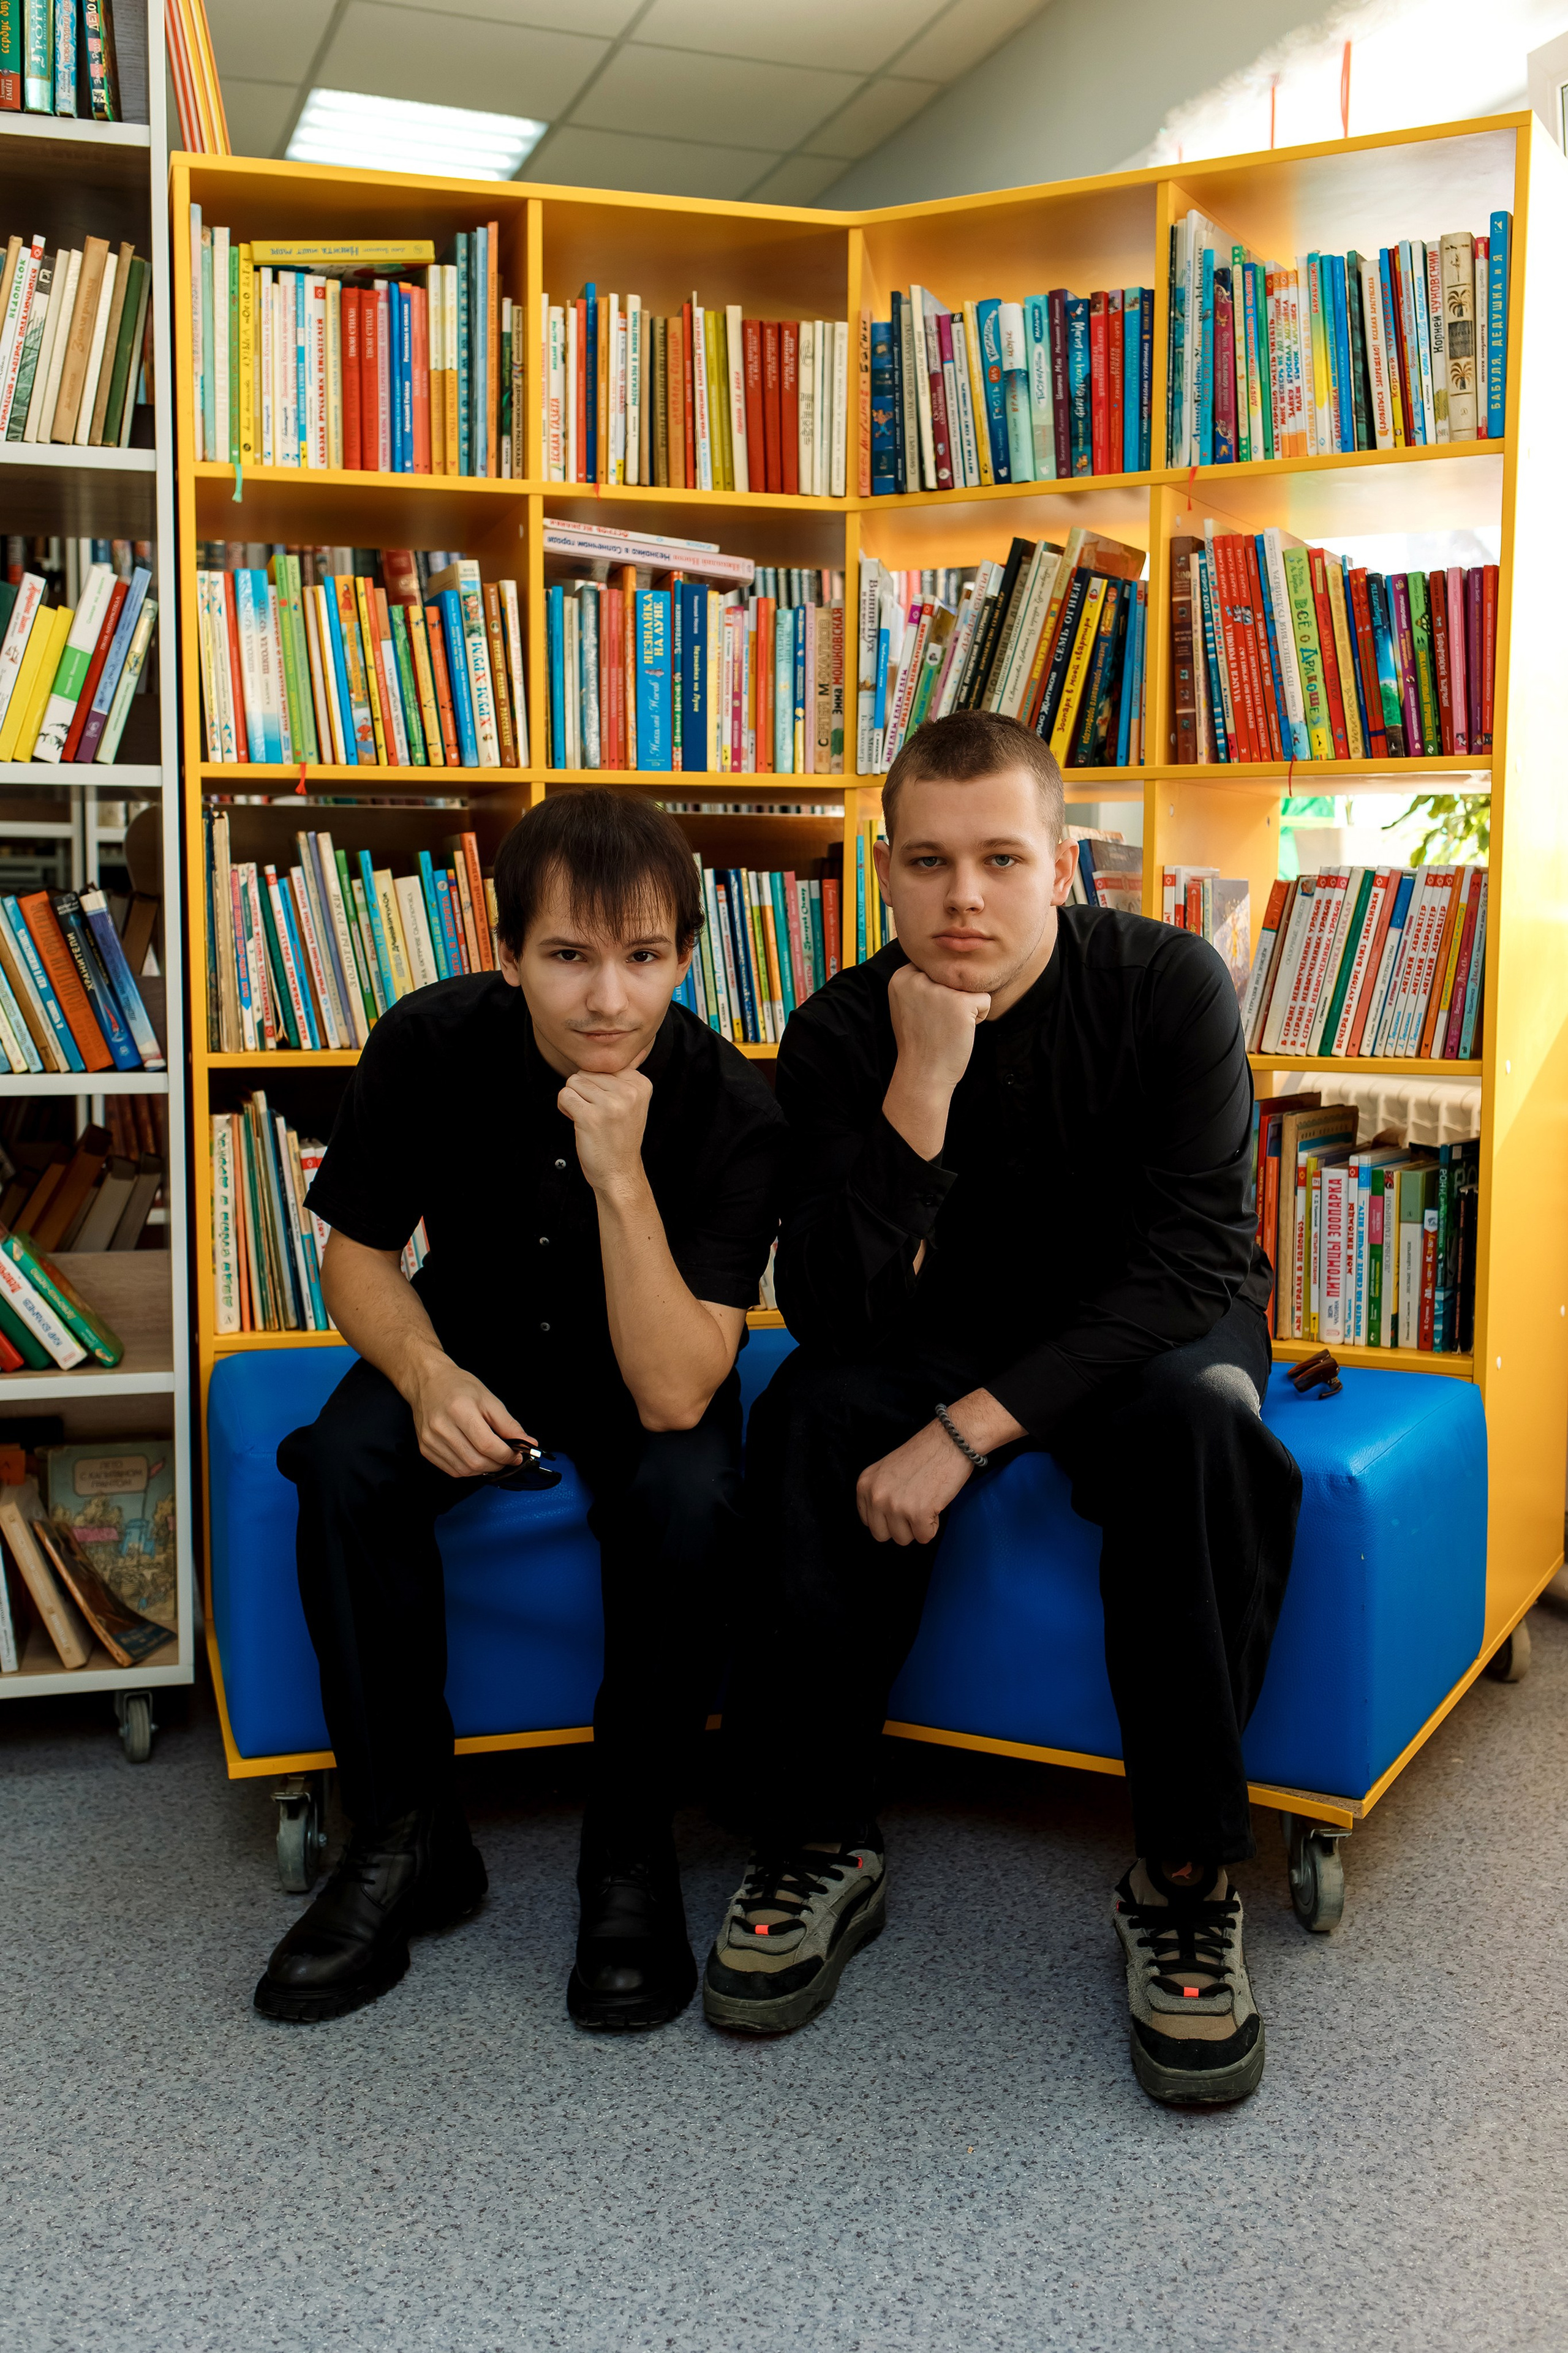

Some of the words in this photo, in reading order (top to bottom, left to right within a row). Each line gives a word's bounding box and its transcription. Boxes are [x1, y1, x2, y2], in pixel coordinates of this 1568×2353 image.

[9, 259, 26, 319] НЕДОПЁСОК
[1310, 262, 1319, 314] БАРАБАШКА
[1427, 250, 1441, 312] ЧУКОВСКИЙ
[1283, 300, 1292, 341] ХОЗЯЙКА
[1381, 282, 1393, 350] ЧУКОВСКИЙ
[1433, 315, 1445, 353] Корней
[1491, 282, 1503, 347] ДЕДУШКА
[315, 319, 324, 373] ПИСАТЕЛЕЙ
[1247, 316, 1256, 377] ПОЖАЛОВАТЬ
[1285, 344, 1294, 384] БРОСИЛА
[1371, 344, 1383, 388] ЗАПРЕЩЕНО!
[1250, 379, 1258, 407] ДОБРО
[1304, 355, 1313, 393] МИШКУ
[1385, 357, 1398, 398] Корней
[1491, 354, 1502, 409] БАБУЛЯ,
[548, 398, 560, 430] ГАЗЕТА
[907, 399, 915, 420] ЗНАК
[1287, 389, 1295, 418] ЗАЙКУ
[1307, 399, 1316, 448] УРОНИЛИ
[1332, 388, 1341, 439] БАРАБАШКА
[1376, 391, 1389, 436] ЦЕЛОВАТЬСЯ
[654, 602, 663, 635] ЛУНЕ
[865, 579, 878, 653] Винни-Пух
[1273, 570, 1285, 618] ГУЛЛИВЕРА
[1295, 597, 1313, 628] ВСЁ
[642, 593, 654, 664] НЕЗНАЙКА
[654, 638, 663, 656] НА
[832, 608, 843, 685] МОШКОВСКАЯ
[1039, 671, 1057, 714] Житков
[1054, 629, 1069, 662] СЕМЬ
[1065, 582, 1082, 624] ОГНЕЙ
[1074, 618, 1090, 661] квартире
[258, 636, 269, 674] ШКОЛА
[818, 619, 830, 696] МИХАЛКОВ
[899, 685, 913, 728] ПРАЗДНИК
[909, 623, 927, 683] НЕПОСЛУШАНИЯ
[1069, 664, 1080, 686] моей
[1096, 642, 1109, 668] Дневник
[1280, 621, 1295, 687] ПУТЕШЕСТВИЯ
[471, 642, 491, 727] ХРУМ-ХРУМ
[832, 688, 843, 715] Эмма
[1299, 648, 1319, 714] ДРАКОШЕ
[818, 702, 830, 747] СЕРГЕЙ
[1056, 698, 1071, 733] Зоопарк
[333, 894, 345, 924] РУКИ
[442, 896, 455, 938] ЗВЕРЯТА
[1362, 893, 1379, 942] ДИКАНЬКИ
[67, 932, 95, 991] ХРАНИТЕЛИ
[341, 931, 358, 988] ЗОЛОТЫЕ
[1283, 1005, 1296, 1037] СТРАНЕ
[1291, 936, 1312, 1002] НЕВЫУЧЕННЫХ
[1308, 899, 1322, 933] УРОКОВ
[1293, 1006, 1305, 1037] СТРАНЕ
[1302, 937, 1322, 1002] НЕВЫУЧЕННЫХ
[1317, 899, 1332, 934] УРОКОВ
[1327, 946, 1341, 986] ДЕВОЧКА
[1338, 901, 1352, 938] КАКАДУ
[1355, 945, 1366, 967] БЛИЗ
[1401, 957, 1414, 994] МЯГКИЙ
[1412, 905, 1427, 951] ХАРАКТЕР
[1411, 957, 1424, 995] МЯГКИЙ
[1421, 906, 1436, 953] ХАРАКТЕР
[1421, 958, 1434, 995] МЯГКИЙ
[1431, 905, 1446, 953] ХАРАКТЕР
[1302, 1008, 1315, 1039] СТРАНЕ
[1310, 938, 1332, 1003] НЕВЫУЧЕННЫХ
[1328, 901, 1341, 935] УРОКОВ
[1347, 970, 1361, 1002] ХУТОРЕ
[1336, 1018, 1349, 1049] ВЕЧЕРА
[1344, 1003, 1353, 1015] НА
[1327, 1179, 1342, 1237] ЗООПАРКА
[1327, 1241, 1342, 1297] ПИТОМЦЫ
